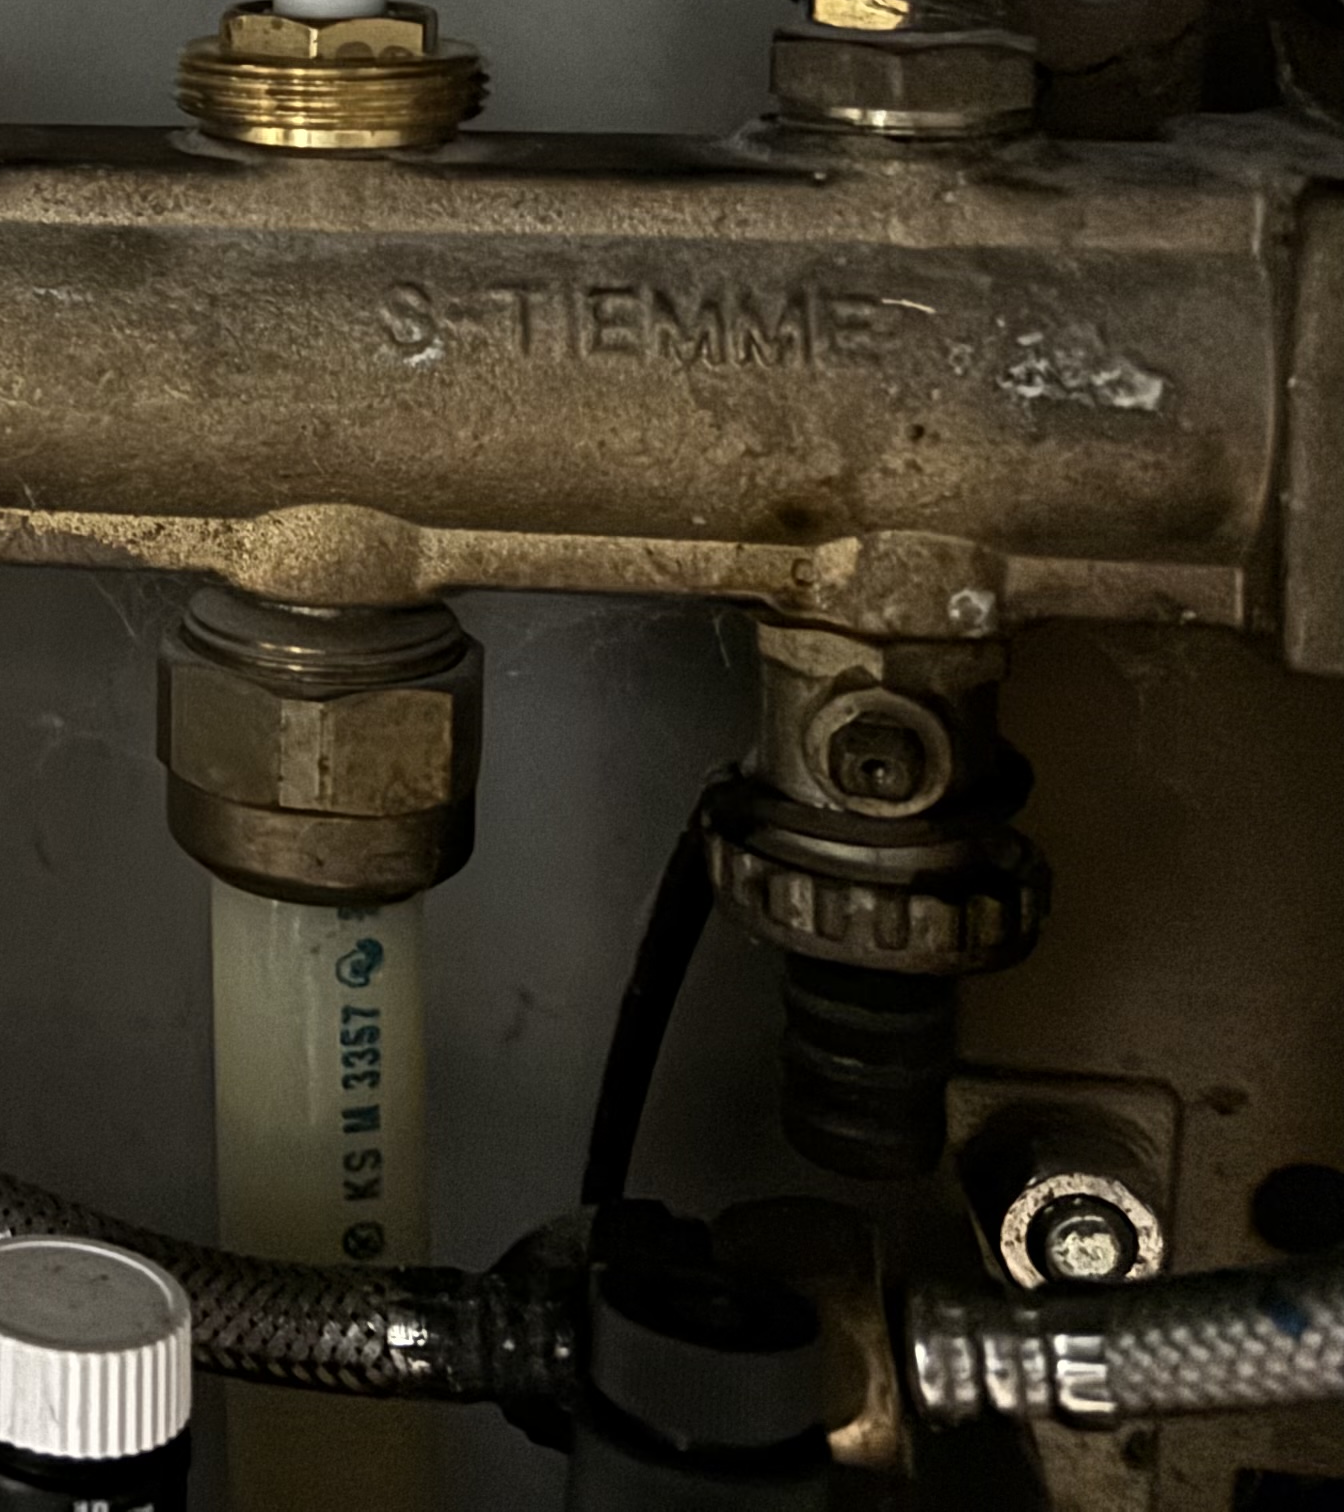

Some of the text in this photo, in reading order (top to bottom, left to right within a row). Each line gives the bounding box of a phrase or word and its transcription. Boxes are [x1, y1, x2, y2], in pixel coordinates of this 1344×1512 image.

[340, 1004, 382, 1201] KS M 3357
